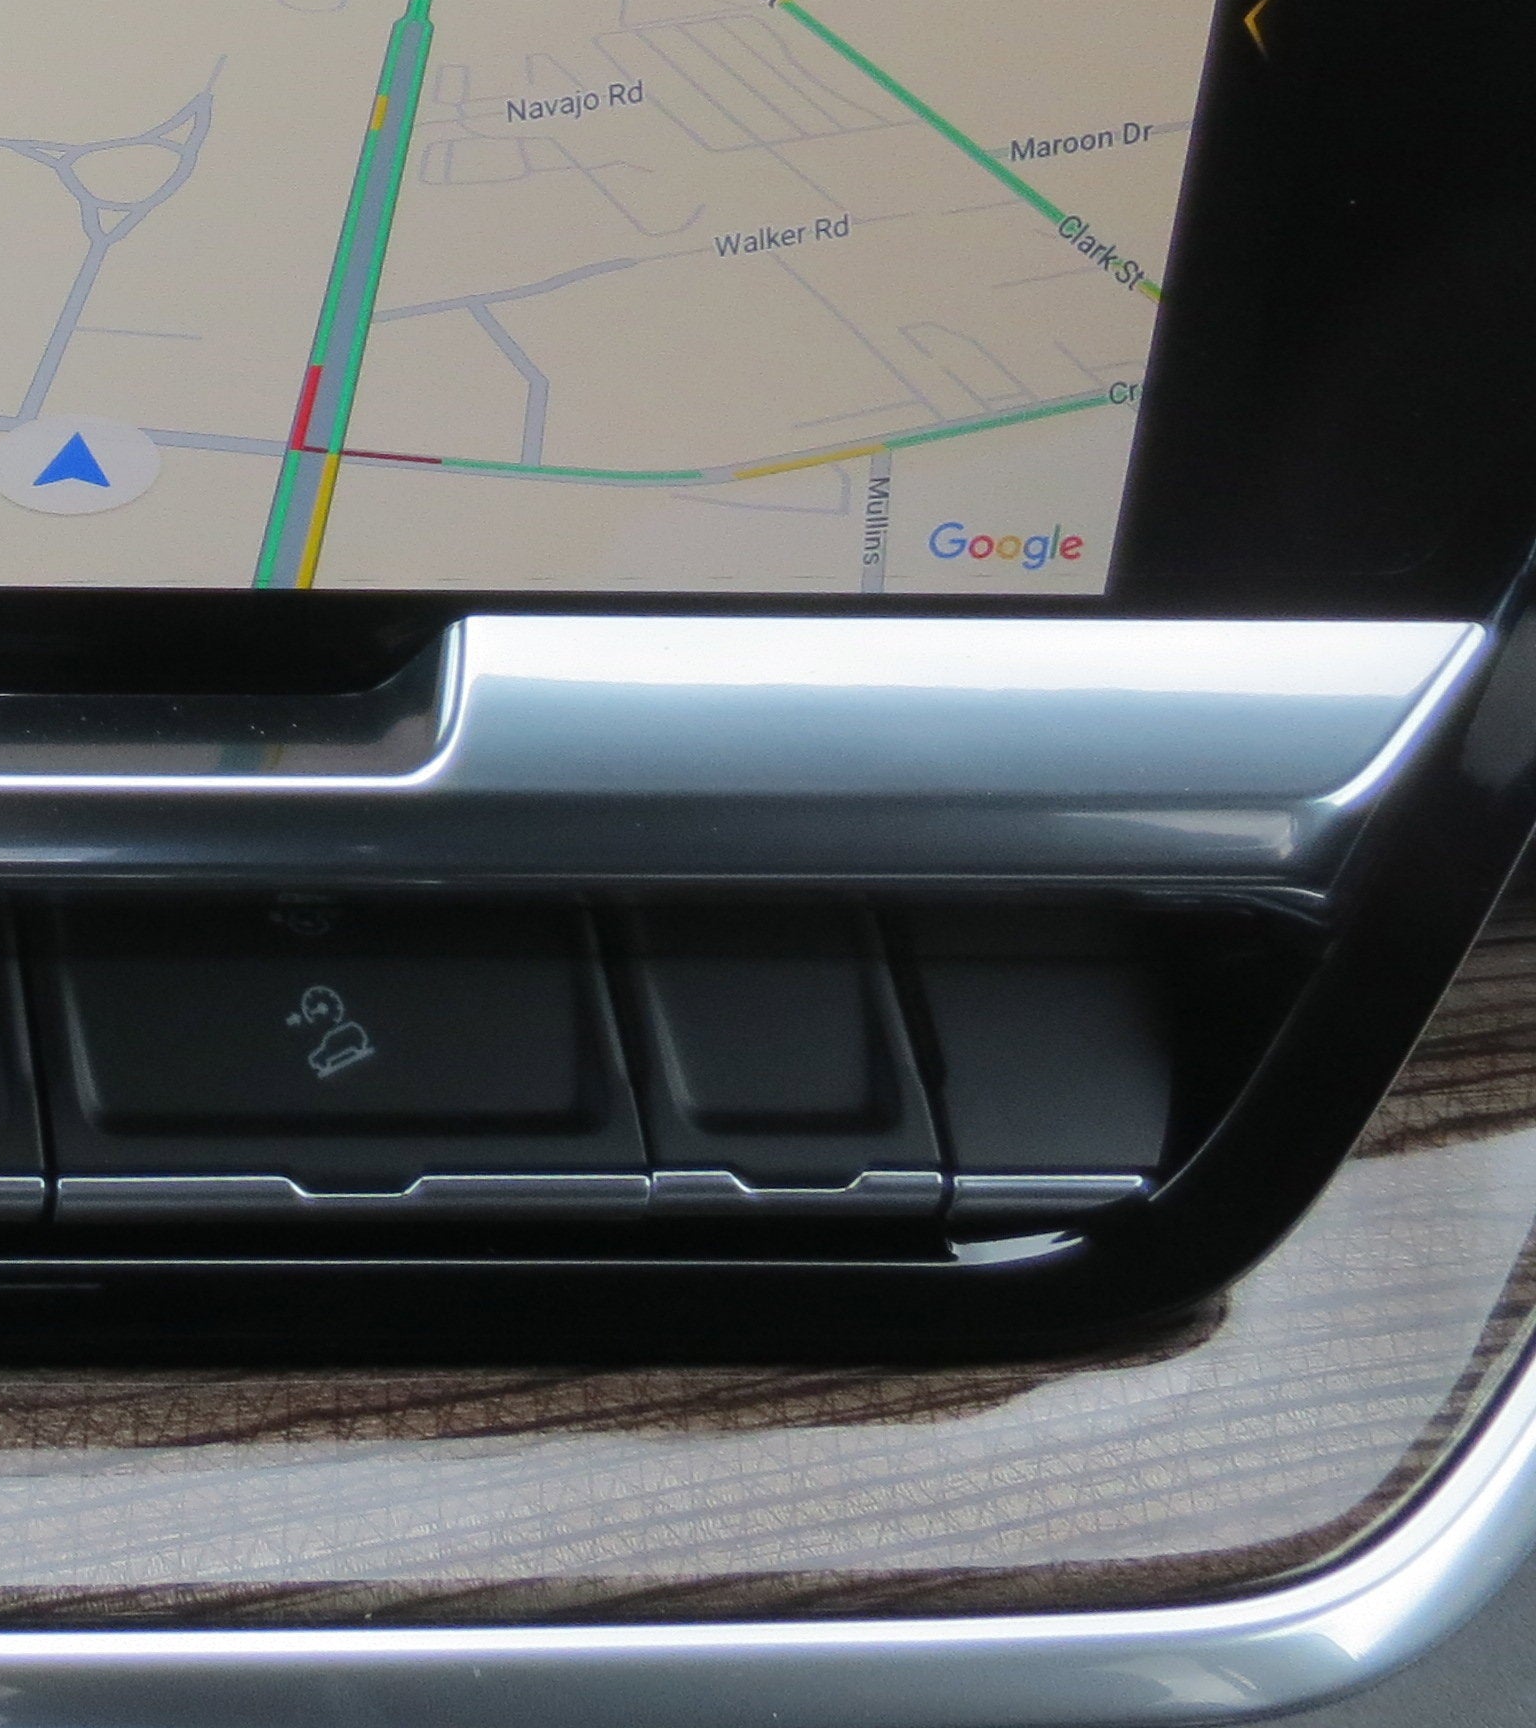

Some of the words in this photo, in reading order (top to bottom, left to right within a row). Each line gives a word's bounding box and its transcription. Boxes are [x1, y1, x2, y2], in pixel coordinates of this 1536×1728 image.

[505, 89, 601, 125] Navajo
[607, 78, 644, 108] Rd
[1009, 127, 1114, 162] Maroon
[1120, 120, 1153, 147] Dr
[714, 220, 809, 257] Walker
[814, 212, 851, 242] Rd
[1056, 213, 1122, 273] Clark
[1112, 257, 1148, 292] St
[861, 474, 891, 566] Mullins
[929, 520, 1085, 571] Google
